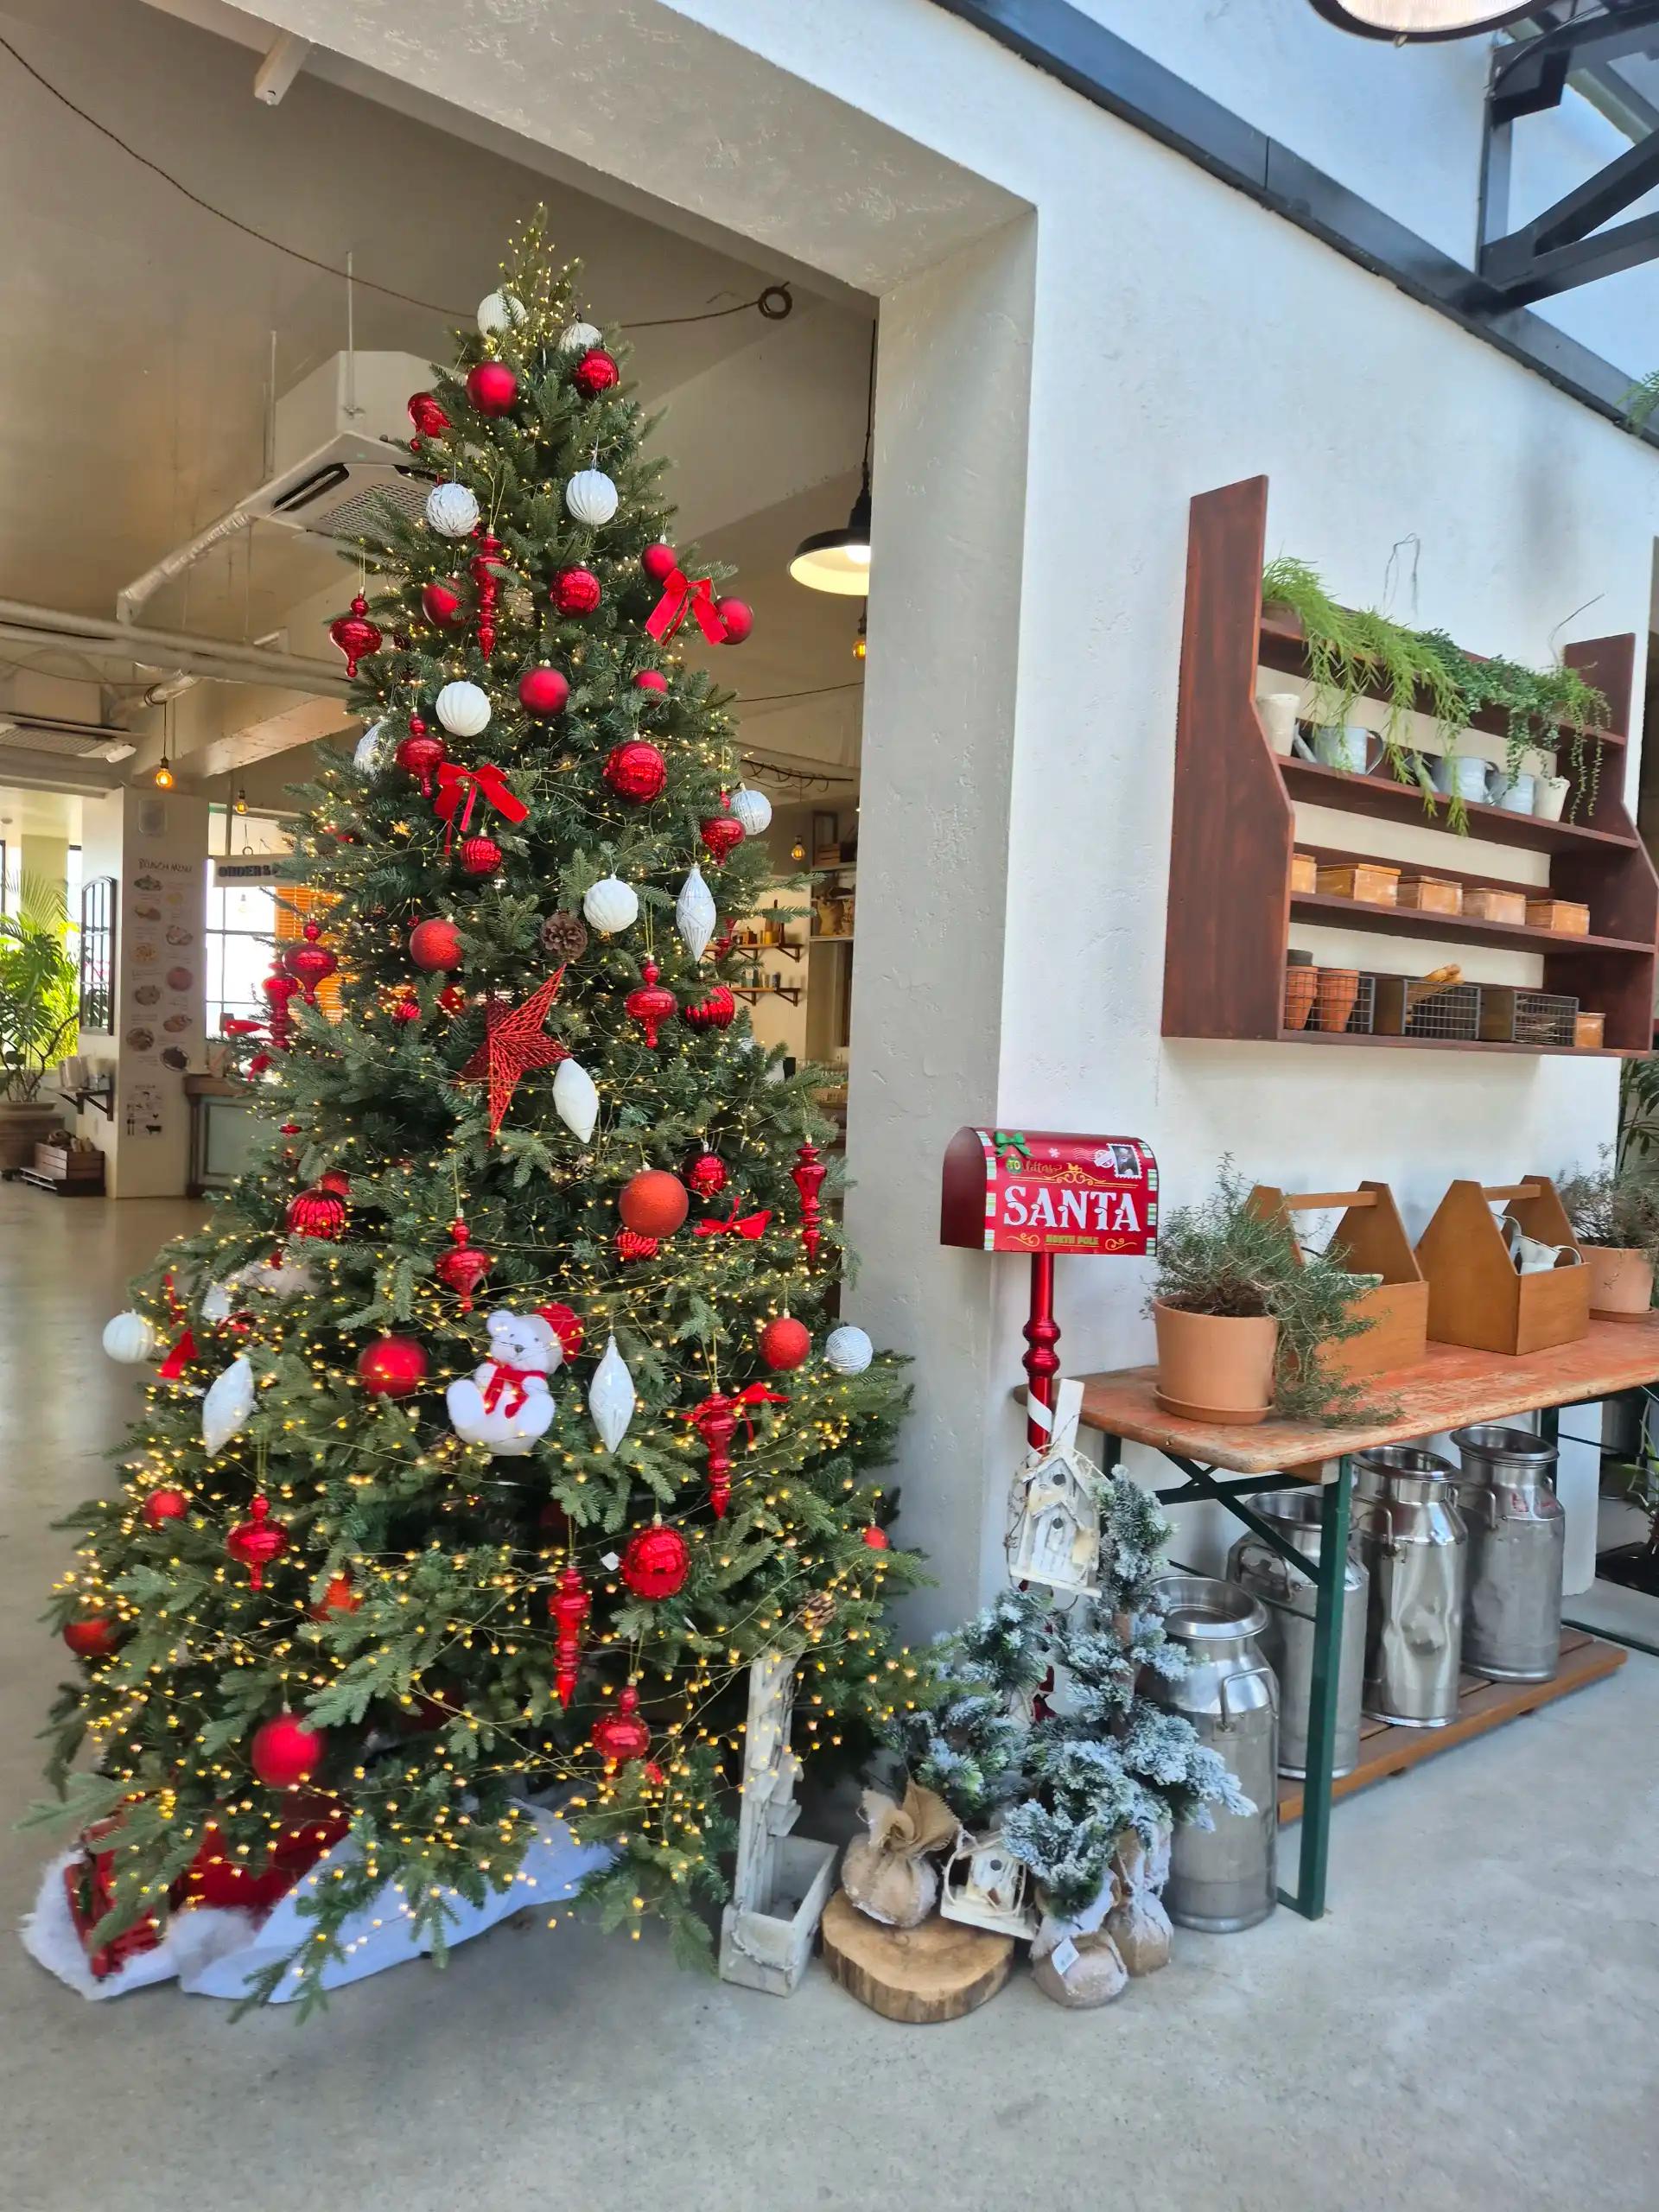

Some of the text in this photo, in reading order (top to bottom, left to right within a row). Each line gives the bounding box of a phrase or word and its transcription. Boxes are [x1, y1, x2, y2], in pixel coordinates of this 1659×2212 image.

[1003, 1185, 1141, 1232] SANTA
[1046, 1234, 1100, 1246] NORTH POLE
